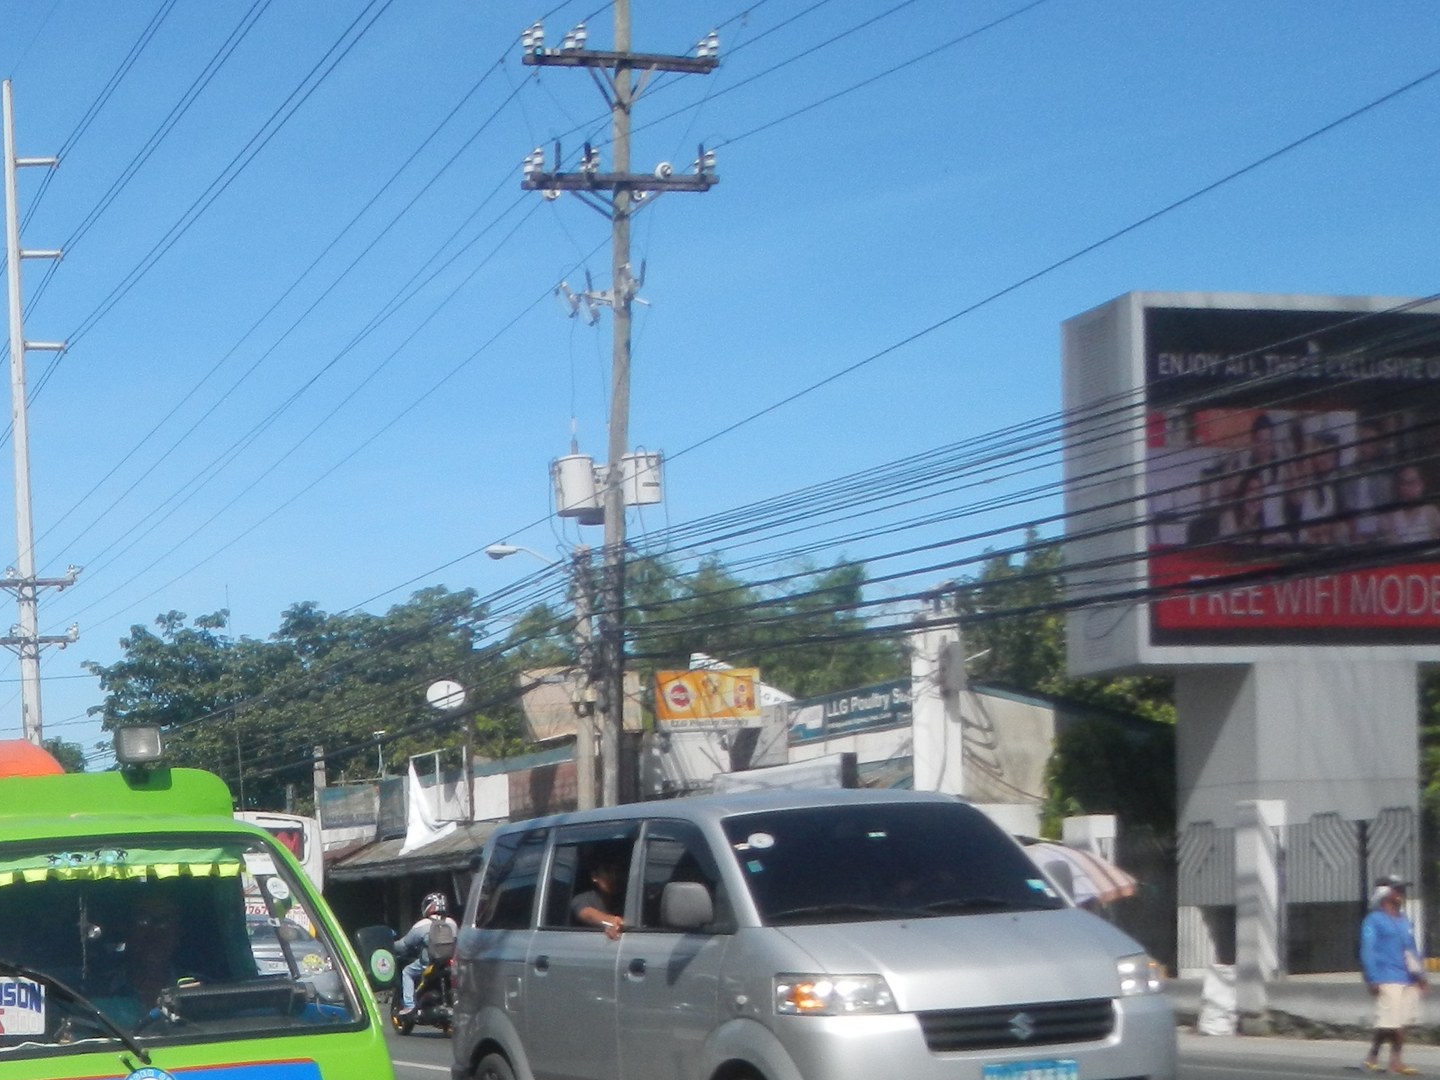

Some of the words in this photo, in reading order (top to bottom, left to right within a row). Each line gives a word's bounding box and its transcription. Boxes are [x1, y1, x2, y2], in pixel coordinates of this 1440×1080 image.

[1158, 353, 1220, 377] ENJOY
[1189, 575, 1264, 616] FREE
[1273, 574, 1340, 615] WIFI
